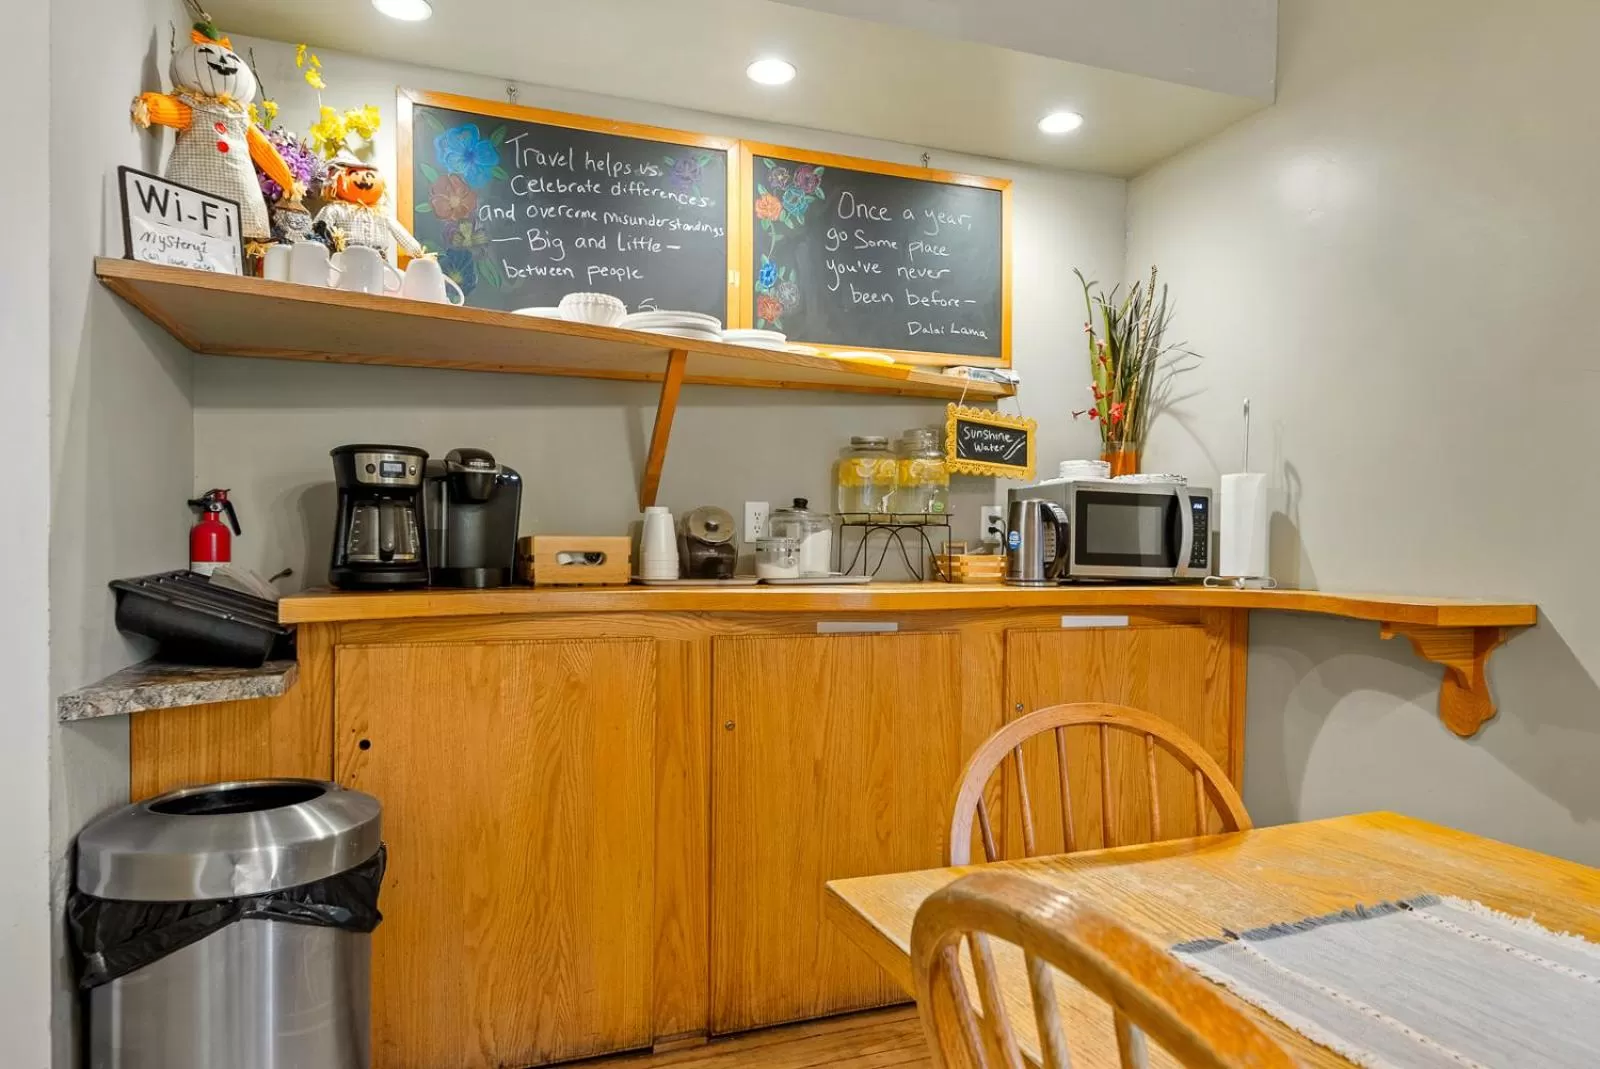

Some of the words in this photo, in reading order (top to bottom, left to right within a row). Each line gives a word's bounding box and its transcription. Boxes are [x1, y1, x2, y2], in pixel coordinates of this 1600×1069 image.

[505, 132, 574, 172] Travel
[585, 150, 631, 177] helps
[510, 175, 601, 196] Celebrate
[135, 180, 232, 237] Wi-Fi
[478, 203, 516, 221] and
[526, 205, 598, 221] overcome
[838, 191, 892, 221] Once
[903, 208, 915, 220] a
[526, 228, 566, 261] Big
[574, 235, 606, 249] and
[825, 227, 848, 251] go
[908, 240, 951, 261] place
[502, 259, 575, 279] between
[588, 265, 644, 285] people
[825, 259, 882, 291] you've
[897, 265, 951, 281] never
[850, 283, 893, 304] been
[907, 321, 945, 335] Dalai
[950, 322, 988, 340] Lama
[973, 442, 1005, 452] Water
